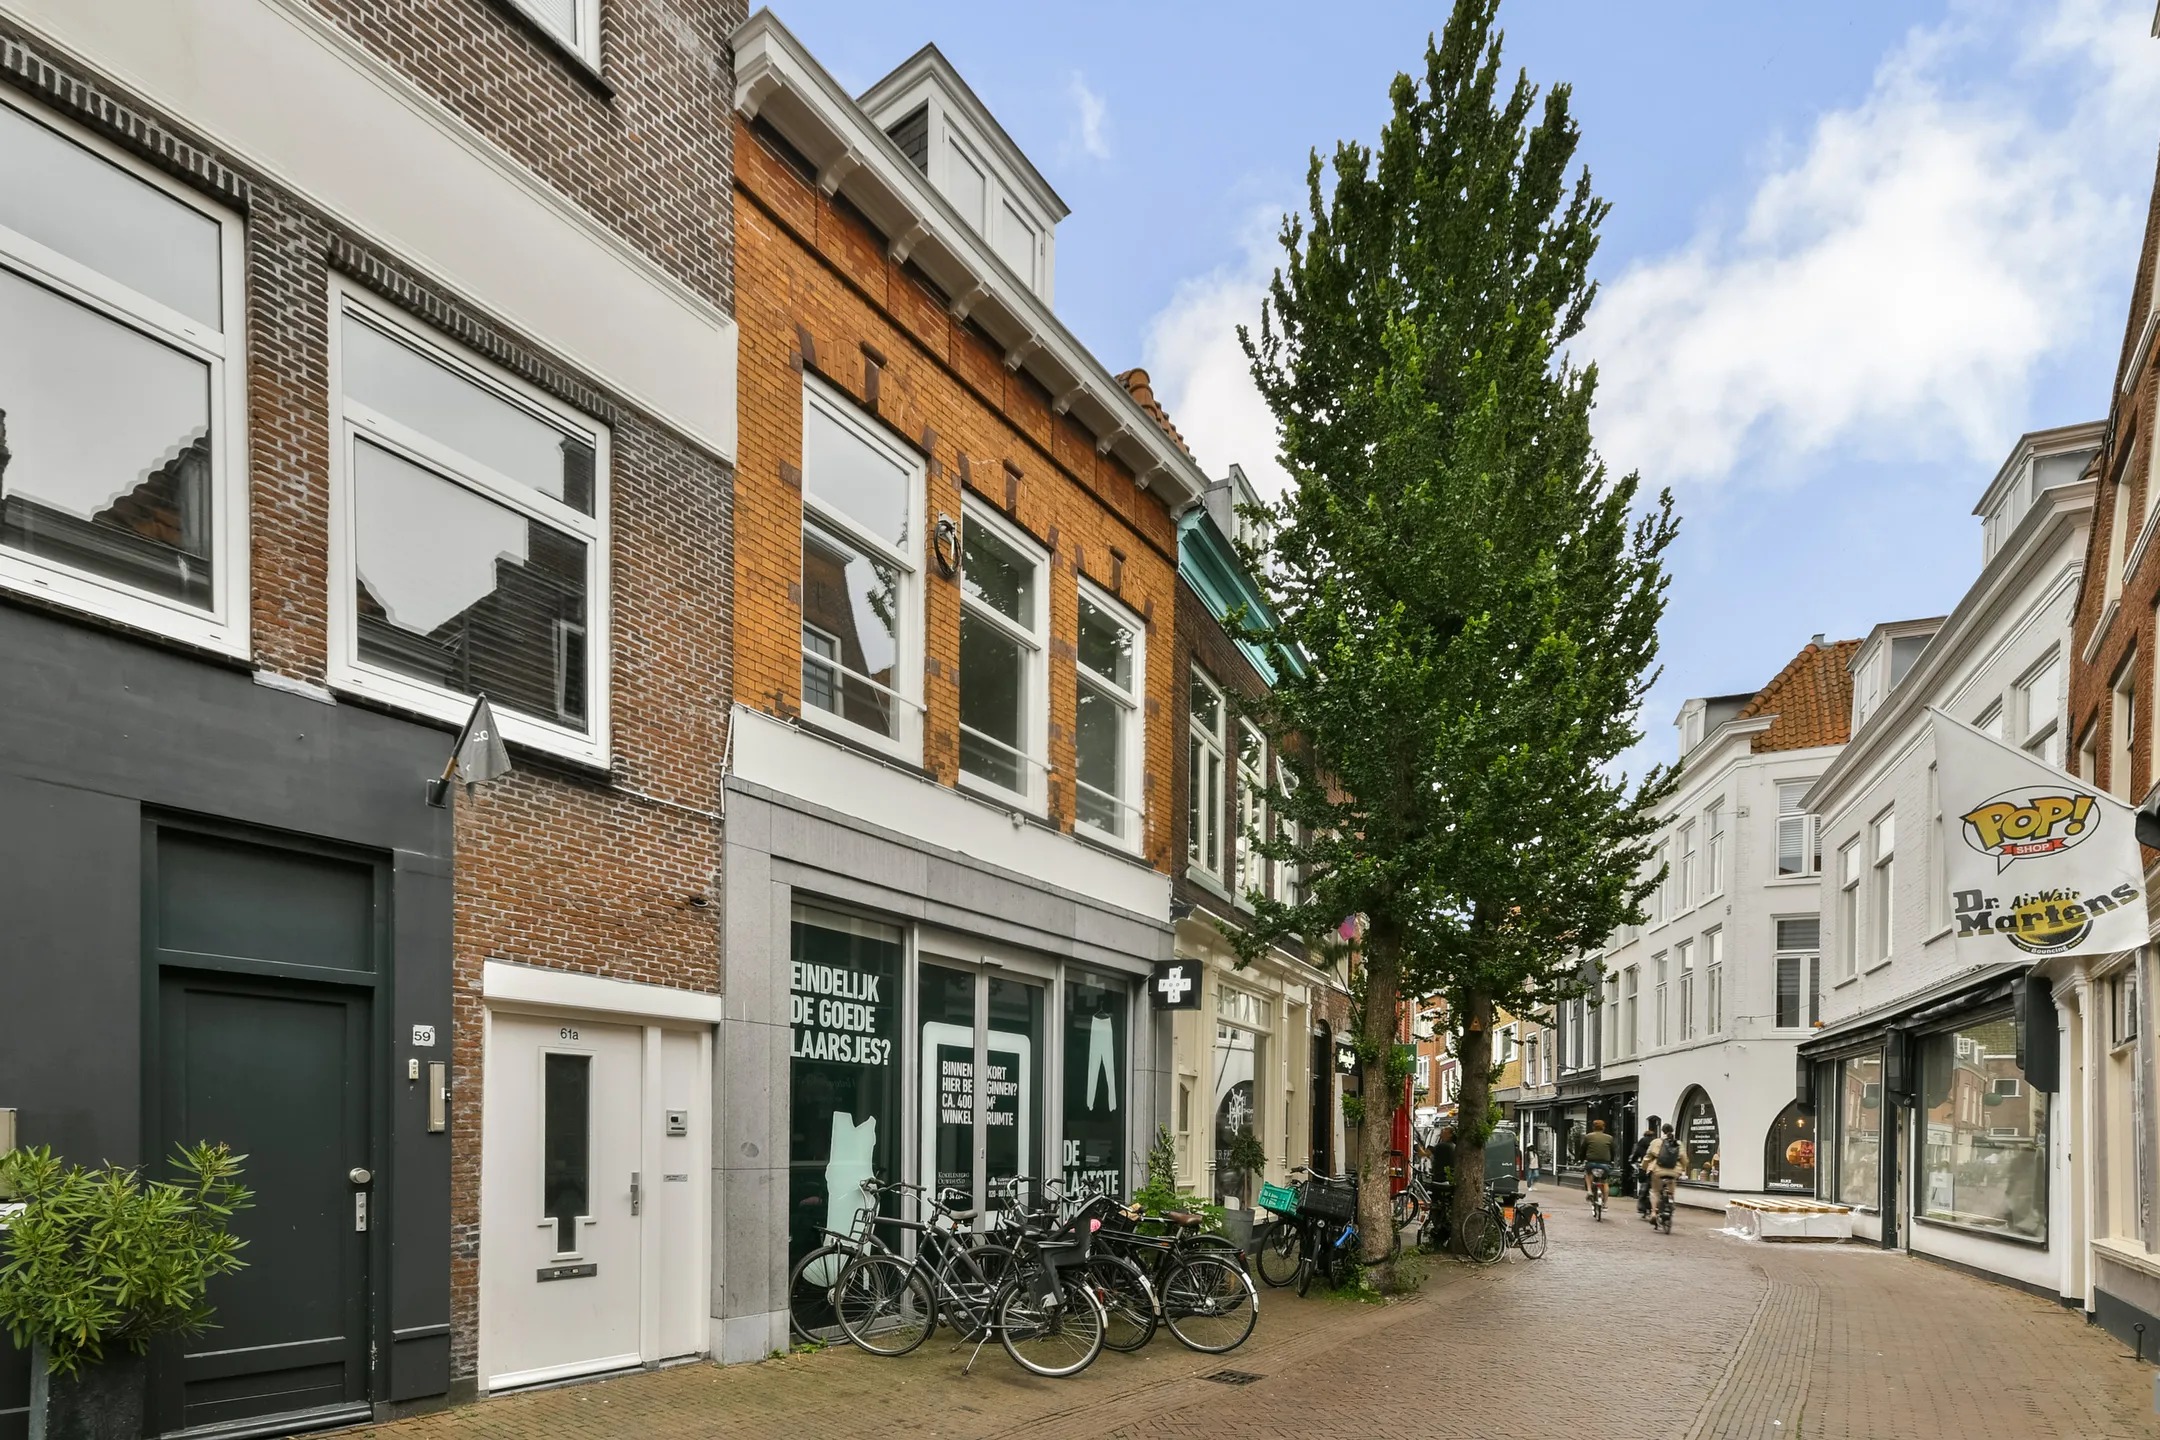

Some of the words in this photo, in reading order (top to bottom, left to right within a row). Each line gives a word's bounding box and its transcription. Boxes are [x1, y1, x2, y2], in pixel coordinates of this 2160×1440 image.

[1959, 795, 2097, 851] POP!
[2016, 843, 2050, 855] SHOP
[1953, 889, 2000, 914] Dr.
[2010, 887, 2080, 910] AirWair
[1955, 883, 2140, 938] Martens
[2030, 945, 2069, 955] Bouncing
[790, 960, 880, 1003] EINDELIJK
[790, 994, 815, 1026] DE
[819, 999, 876, 1033] GOEDE
[560, 1027, 579, 1040] 61a
[790, 1027, 891, 1066] LAARSJES?
[942, 1060, 973, 1078] BINNEN
[987, 1065, 1007, 1080] KORT
[942, 1077, 961, 1093] HIER
[942, 1093, 956, 1108] CA.
[957, 1094, 973, 1109] 400
[942, 1109, 973, 1125] WINKEL
[986, 1111, 1014, 1126] RUIMTE
[1063, 1140, 1081, 1167] DE
